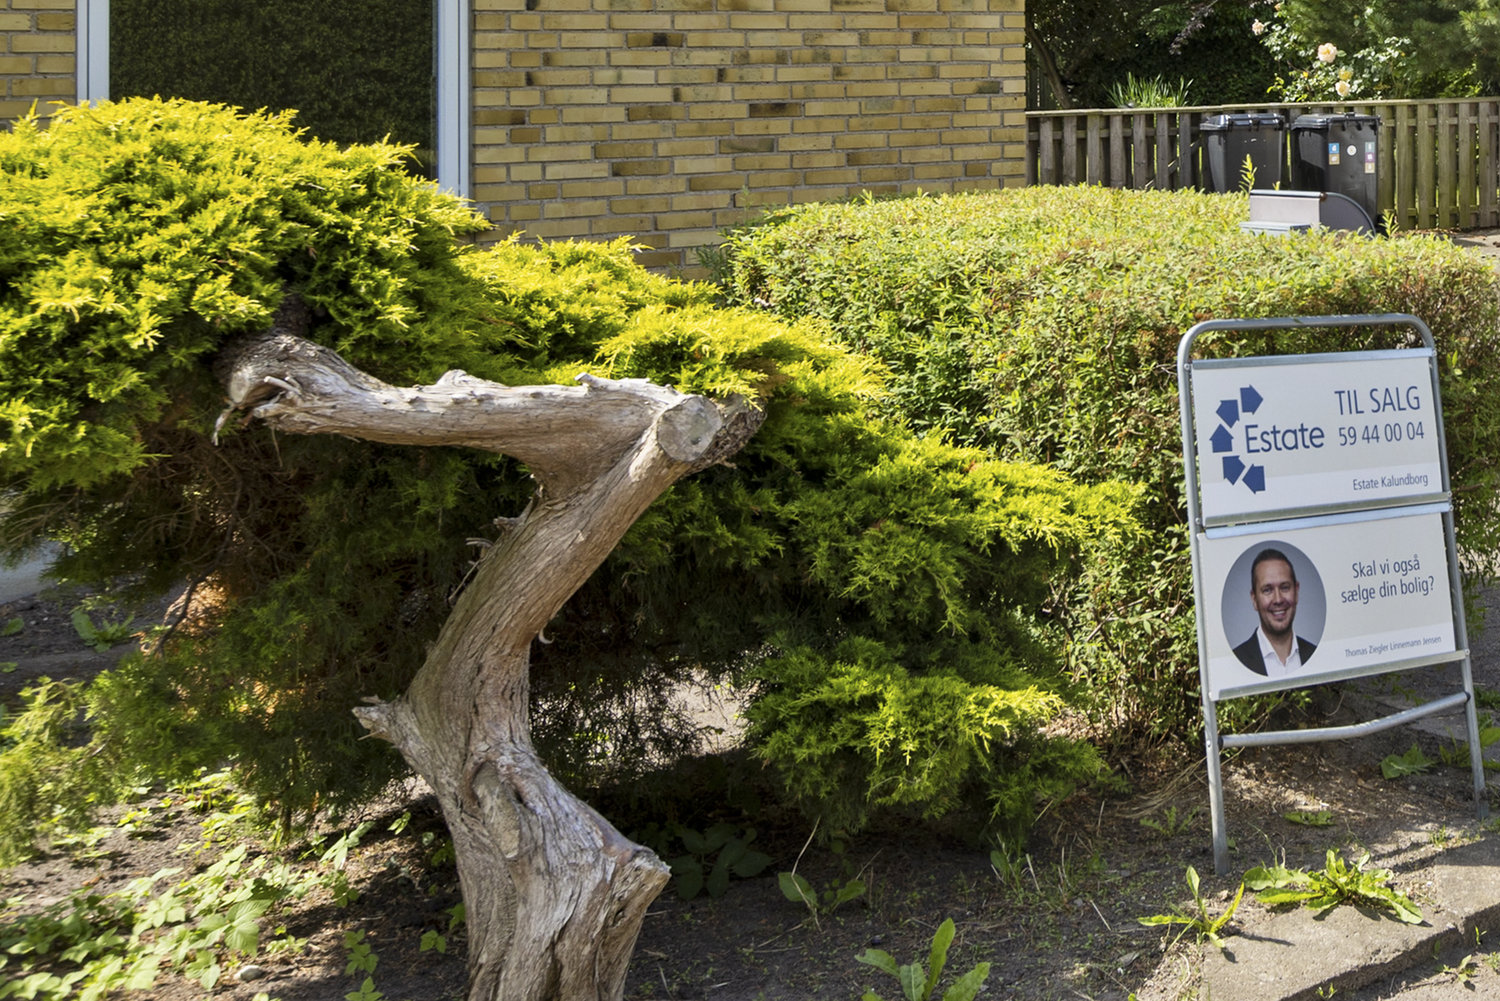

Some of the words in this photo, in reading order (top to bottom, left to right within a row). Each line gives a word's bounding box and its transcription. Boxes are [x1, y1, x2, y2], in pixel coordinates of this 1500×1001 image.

[1334, 389, 1364, 415] TIL
[1370, 386, 1421, 413] SALG
[1245, 422, 1325, 453] Estate
[1339, 426, 1357, 446] 59
[1362, 425, 1380, 444] 44
[1384, 423, 1402, 442] 00
[1406, 421, 1425, 440] 04
[1352, 479, 1379, 491] Estate
[1381, 473, 1429, 489] Kalundborg
[1352, 560, 1377, 579] Skal
[1379, 557, 1390, 574] vi
[1393, 554, 1420, 576] også
[1341, 584, 1376, 605] sælge
[1379, 581, 1398, 598] din
[1400, 575, 1434, 596] bolig?
[1345, 647, 1368, 657] Thomas
